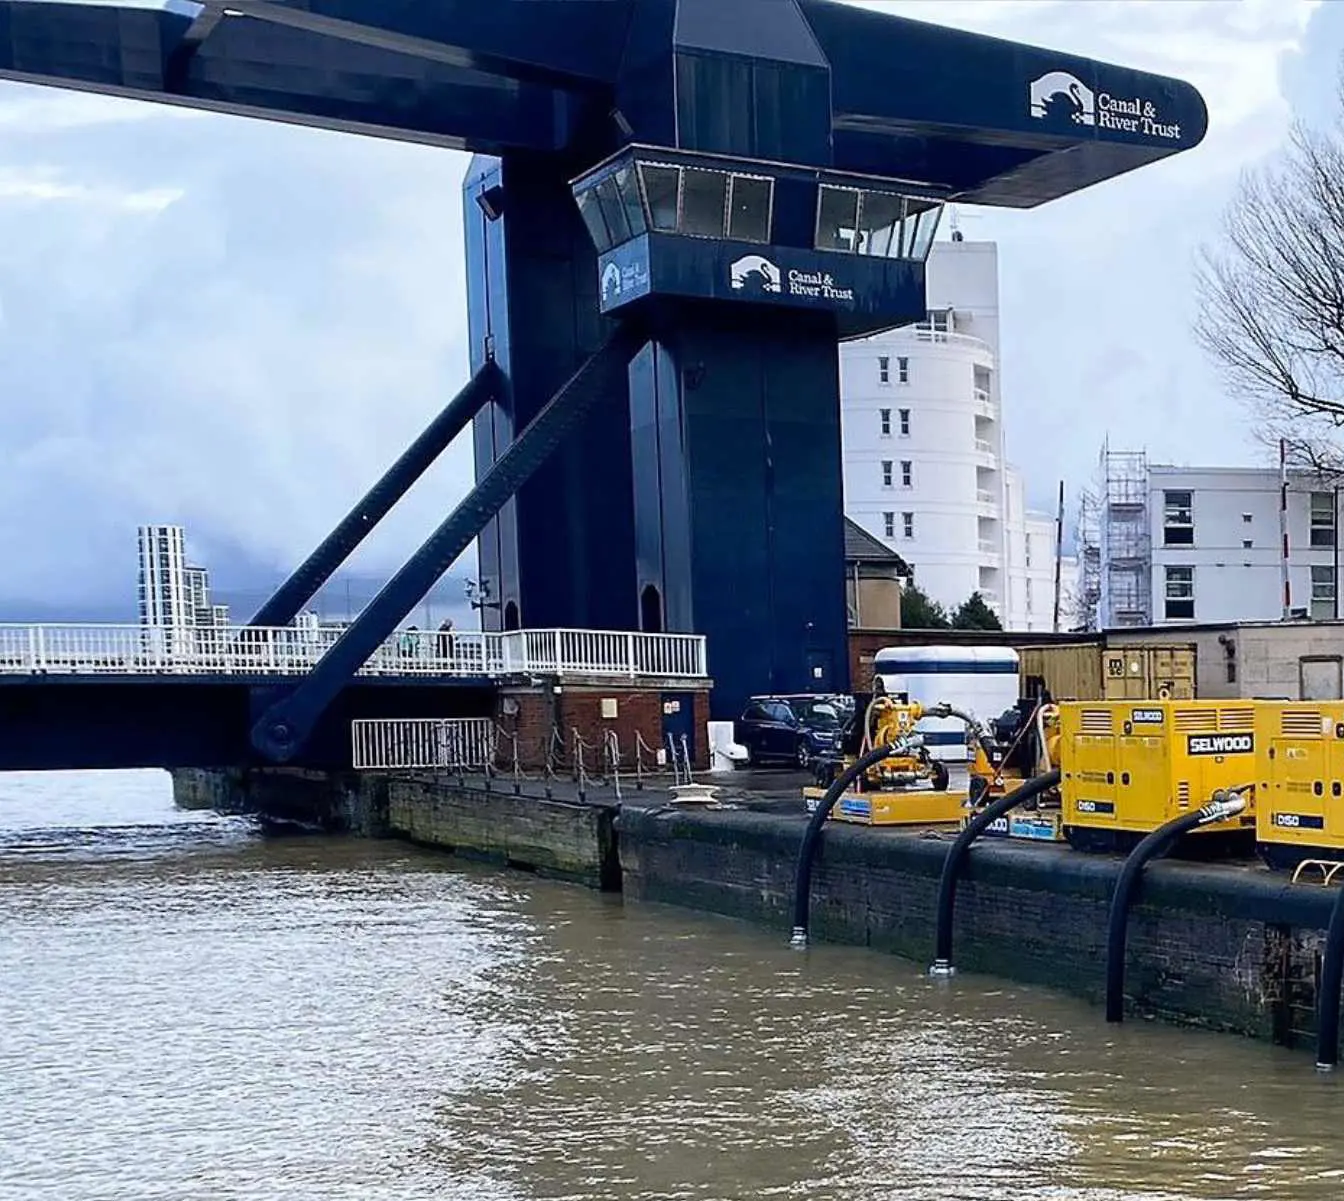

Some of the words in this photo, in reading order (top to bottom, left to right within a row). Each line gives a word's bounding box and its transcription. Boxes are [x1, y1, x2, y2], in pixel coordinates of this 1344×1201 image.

[1099, 93, 1141, 116] Canal
[1144, 102, 1156, 118] &
[1099, 111, 1139, 132] River
[1141, 117, 1181, 139] Trust
[788, 269, 822, 284] Canal
[823, 275, 834, 286] &
[789, 283, 822, 297] River
[822, 286, 853, 300] Trust
[1189, 736, 1252, 753] SELWOOD
